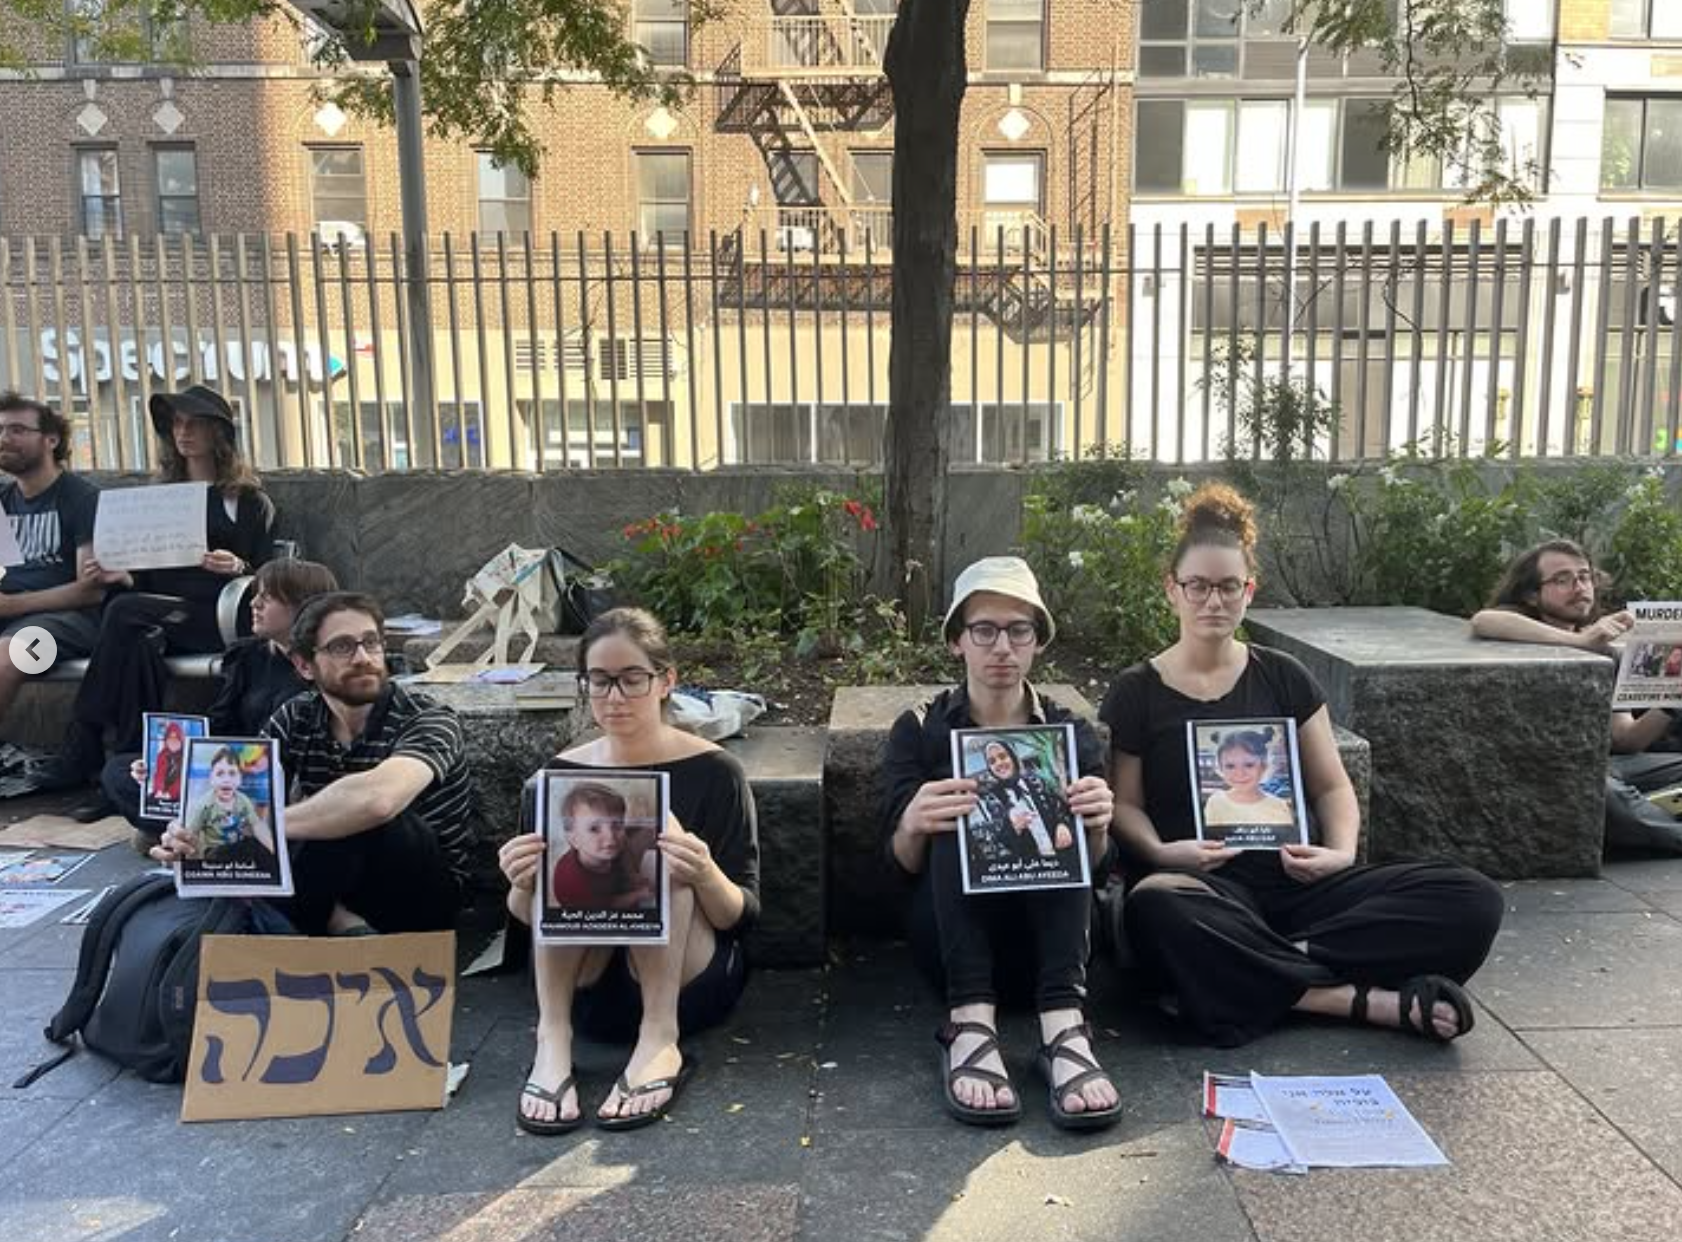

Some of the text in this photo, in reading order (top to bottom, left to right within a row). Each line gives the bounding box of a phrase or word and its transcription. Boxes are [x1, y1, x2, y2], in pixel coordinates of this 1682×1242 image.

[40, 326, 325, 394] Specrum
[1636, 608, 1682, 620] MURDE
[201, 964, 446, 1084] איכה
